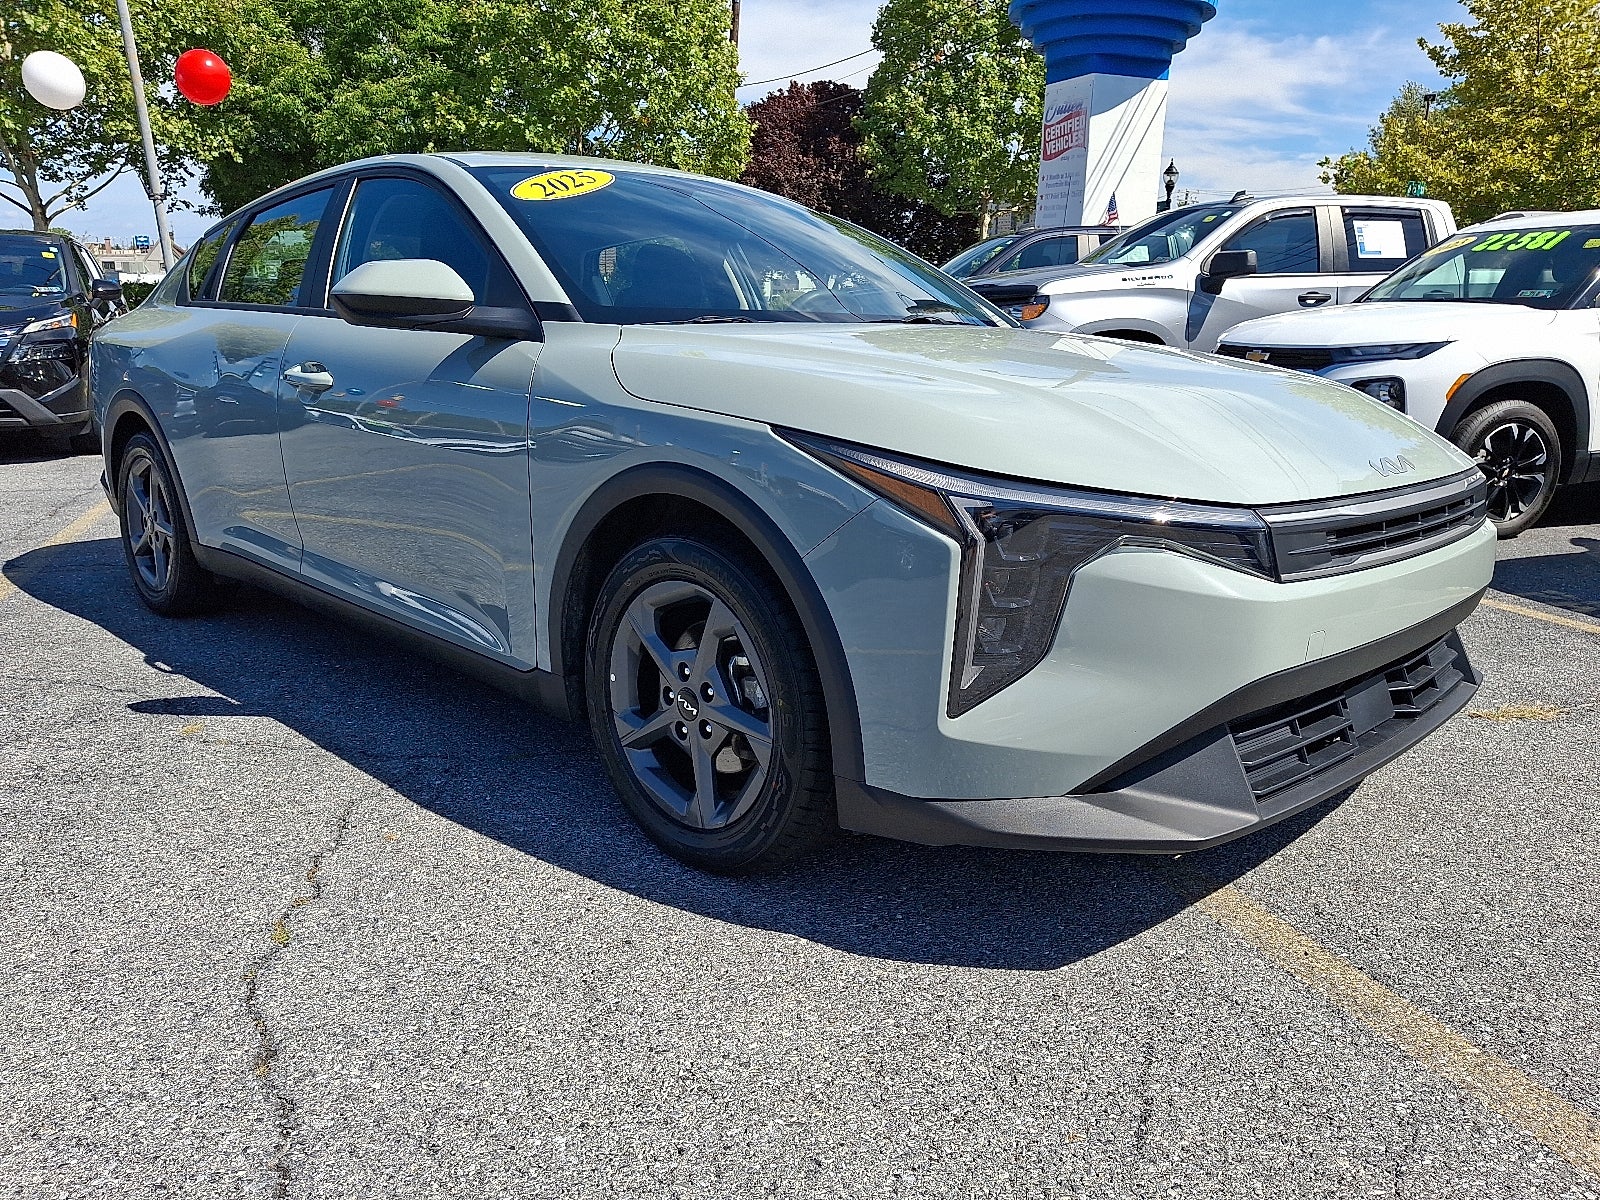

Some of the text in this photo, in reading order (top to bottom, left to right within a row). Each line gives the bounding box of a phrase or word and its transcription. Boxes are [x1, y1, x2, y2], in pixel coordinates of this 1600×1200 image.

[1045, 115, 1087, 142] CERTIFIED
[1046, 130, 1085, 156] VEHICLES
[530, 171, 597, 197] 2025
[1471, 230, 1572, 251] 22581
[1121, 274, 1174, 282] SILVERADO
